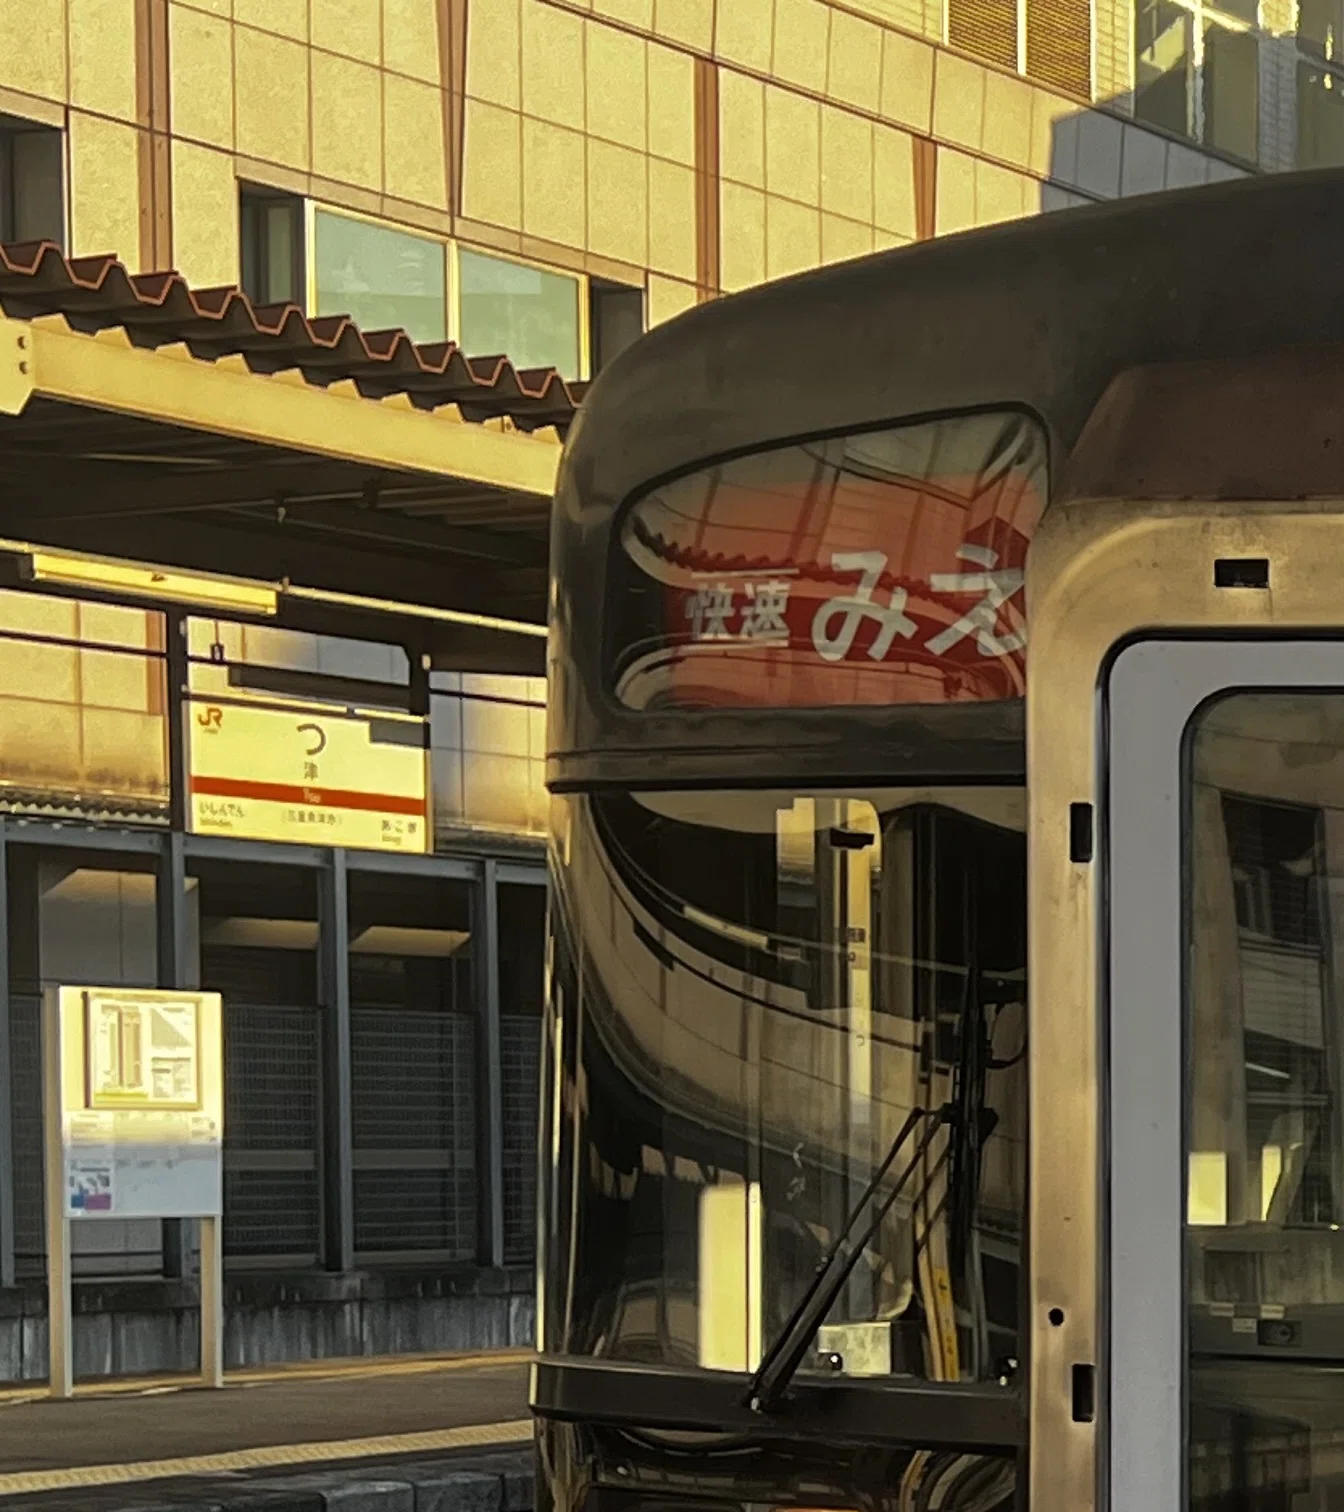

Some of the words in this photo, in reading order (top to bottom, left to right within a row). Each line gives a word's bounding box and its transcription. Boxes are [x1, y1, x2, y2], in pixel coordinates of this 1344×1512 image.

[684, 578, 792, 642] 快速
[811, 543, 1028, 662] みえ
[197, 707, 223, 728] JR
[296, 723, 327, 756] つ
[303, 760, 319, 781] 津
